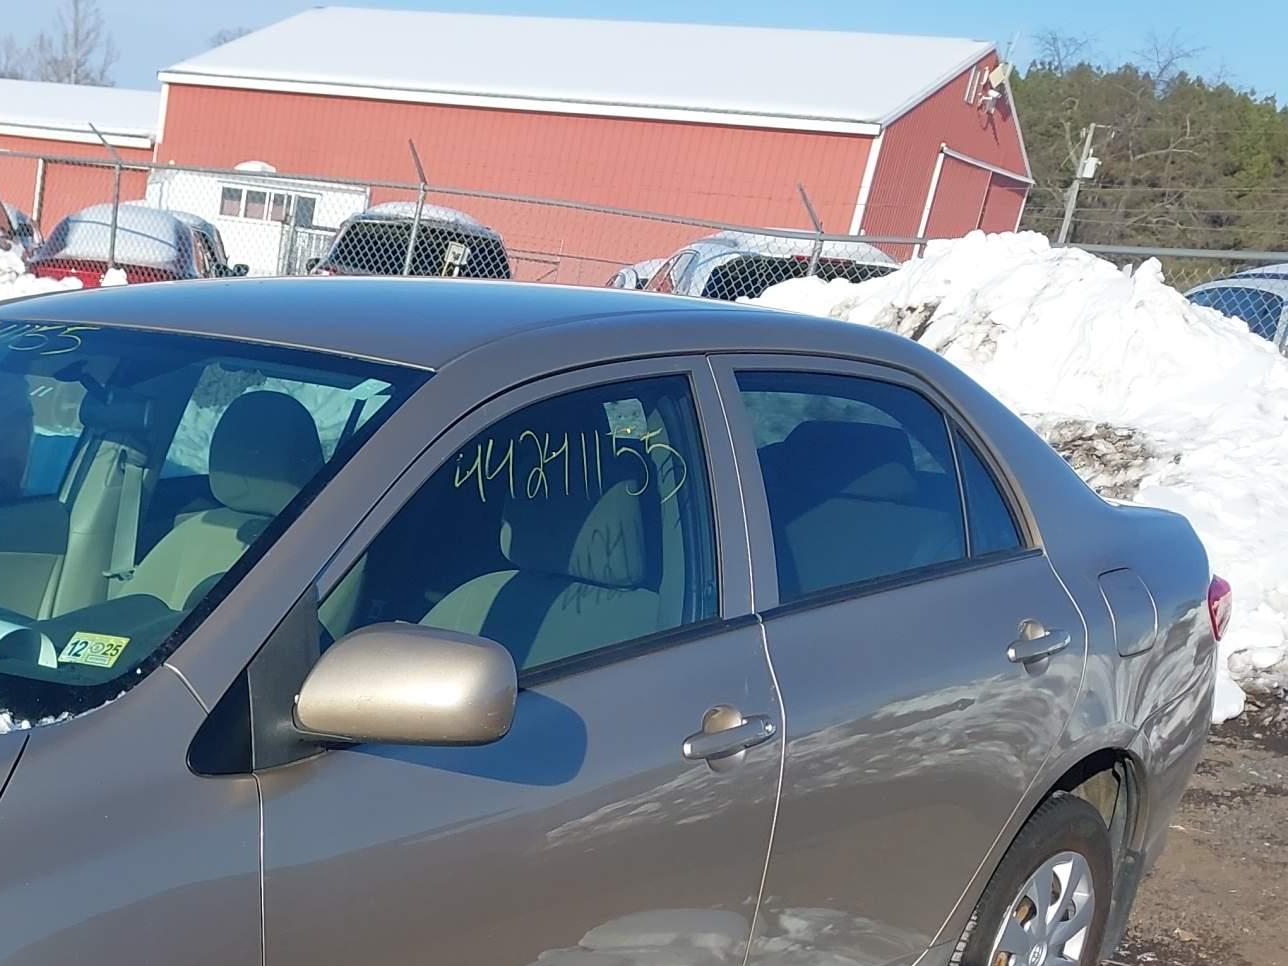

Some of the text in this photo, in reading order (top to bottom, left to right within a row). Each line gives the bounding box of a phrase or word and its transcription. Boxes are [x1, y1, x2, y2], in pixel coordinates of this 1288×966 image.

[454, 428, 687, 503] 44241155
[67, 640, 122, 657] 12 25
